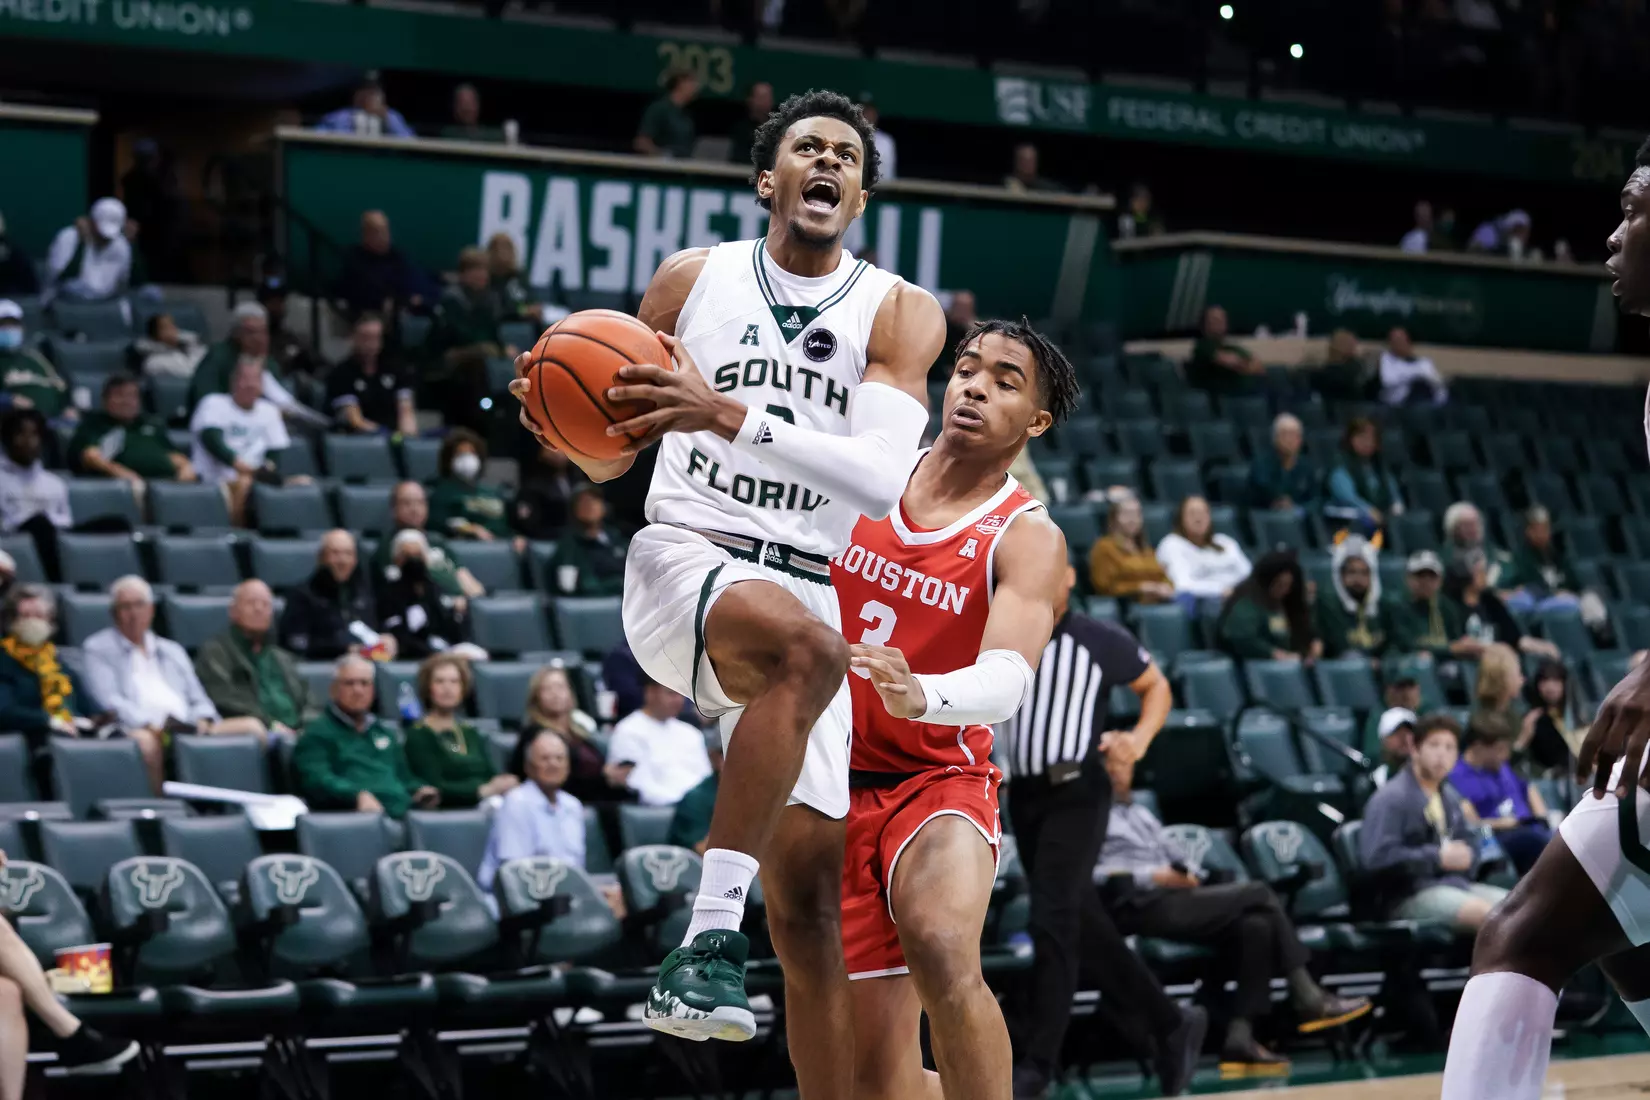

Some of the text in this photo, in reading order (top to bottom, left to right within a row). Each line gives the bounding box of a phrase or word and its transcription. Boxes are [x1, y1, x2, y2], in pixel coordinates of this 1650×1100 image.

[478, 172, 952, 306] BASKETLL
[782, 322, 803, 330] adidas
[715, 358, 848, 417] SOUTH
[687, 447, 831, 511] FLORID
[764, 551, 783, 565] didas
